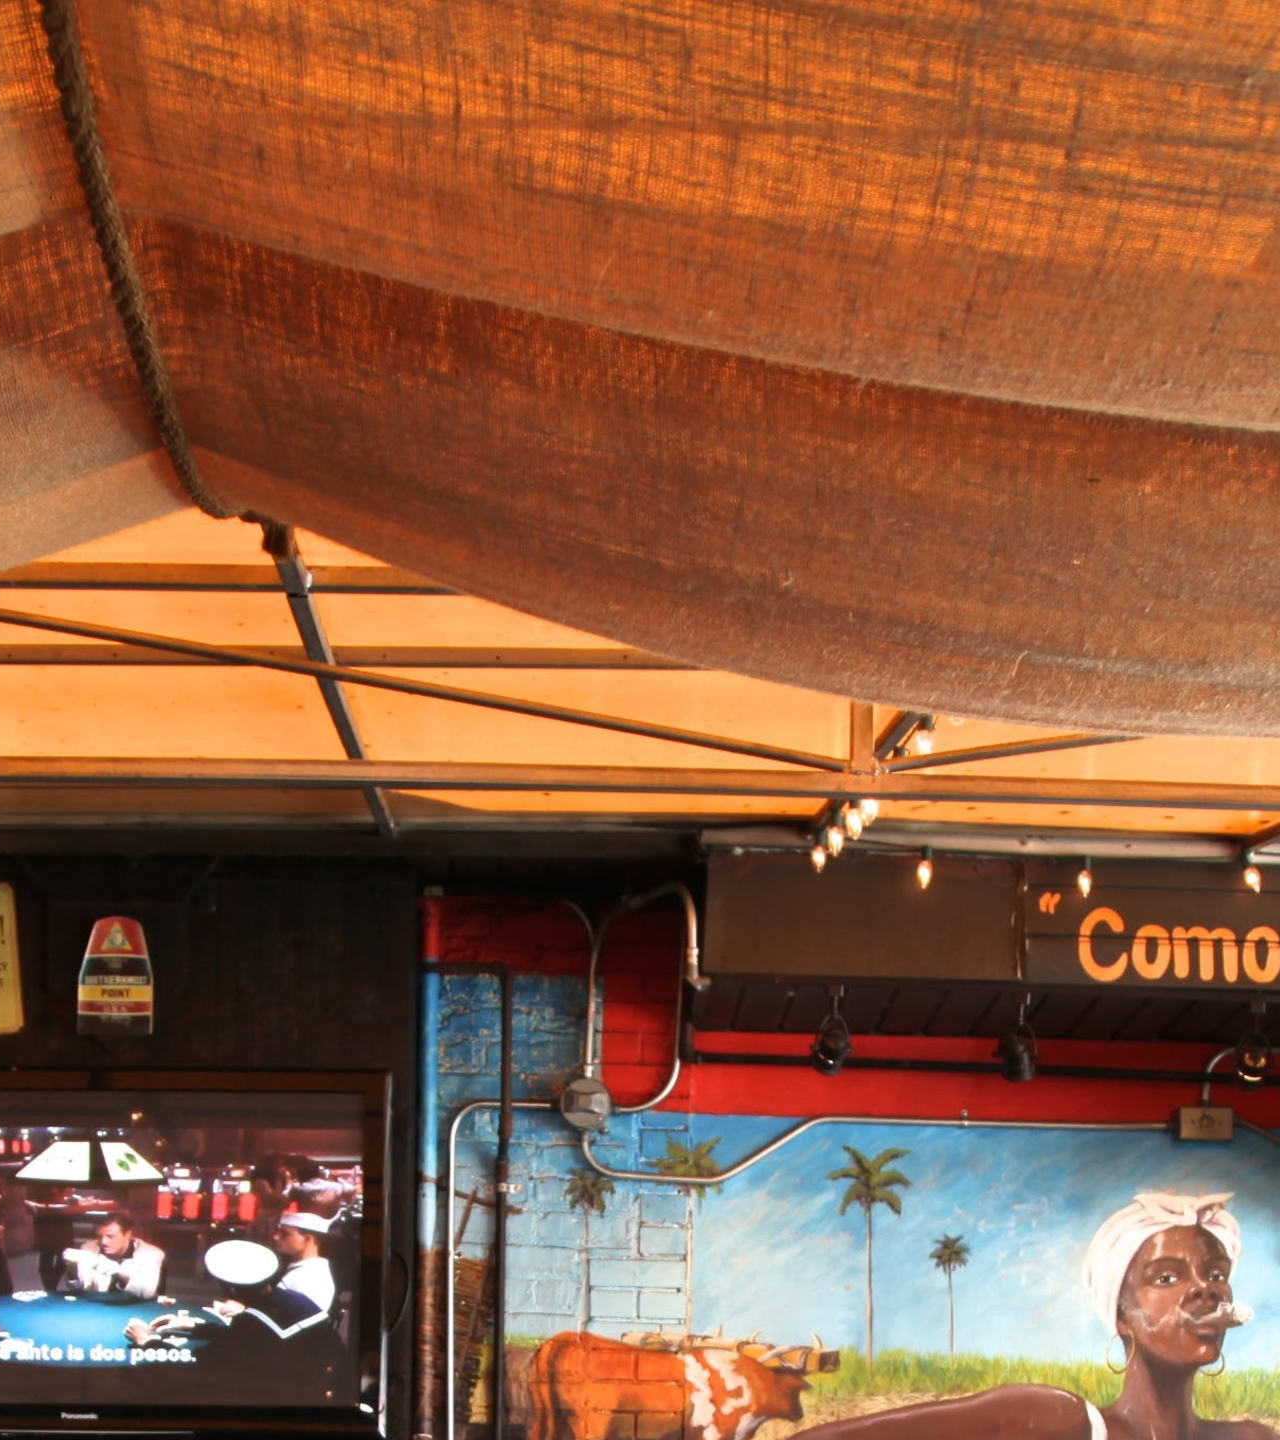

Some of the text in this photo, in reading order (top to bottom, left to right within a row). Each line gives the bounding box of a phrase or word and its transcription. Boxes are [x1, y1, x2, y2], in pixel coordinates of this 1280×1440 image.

[16, 1344, 62, 1361] ante
[67, 1344, 84, 1361] is
[90, 1344, 126, 1361] dos
[130, 1348, 197, 1366] pesos.
